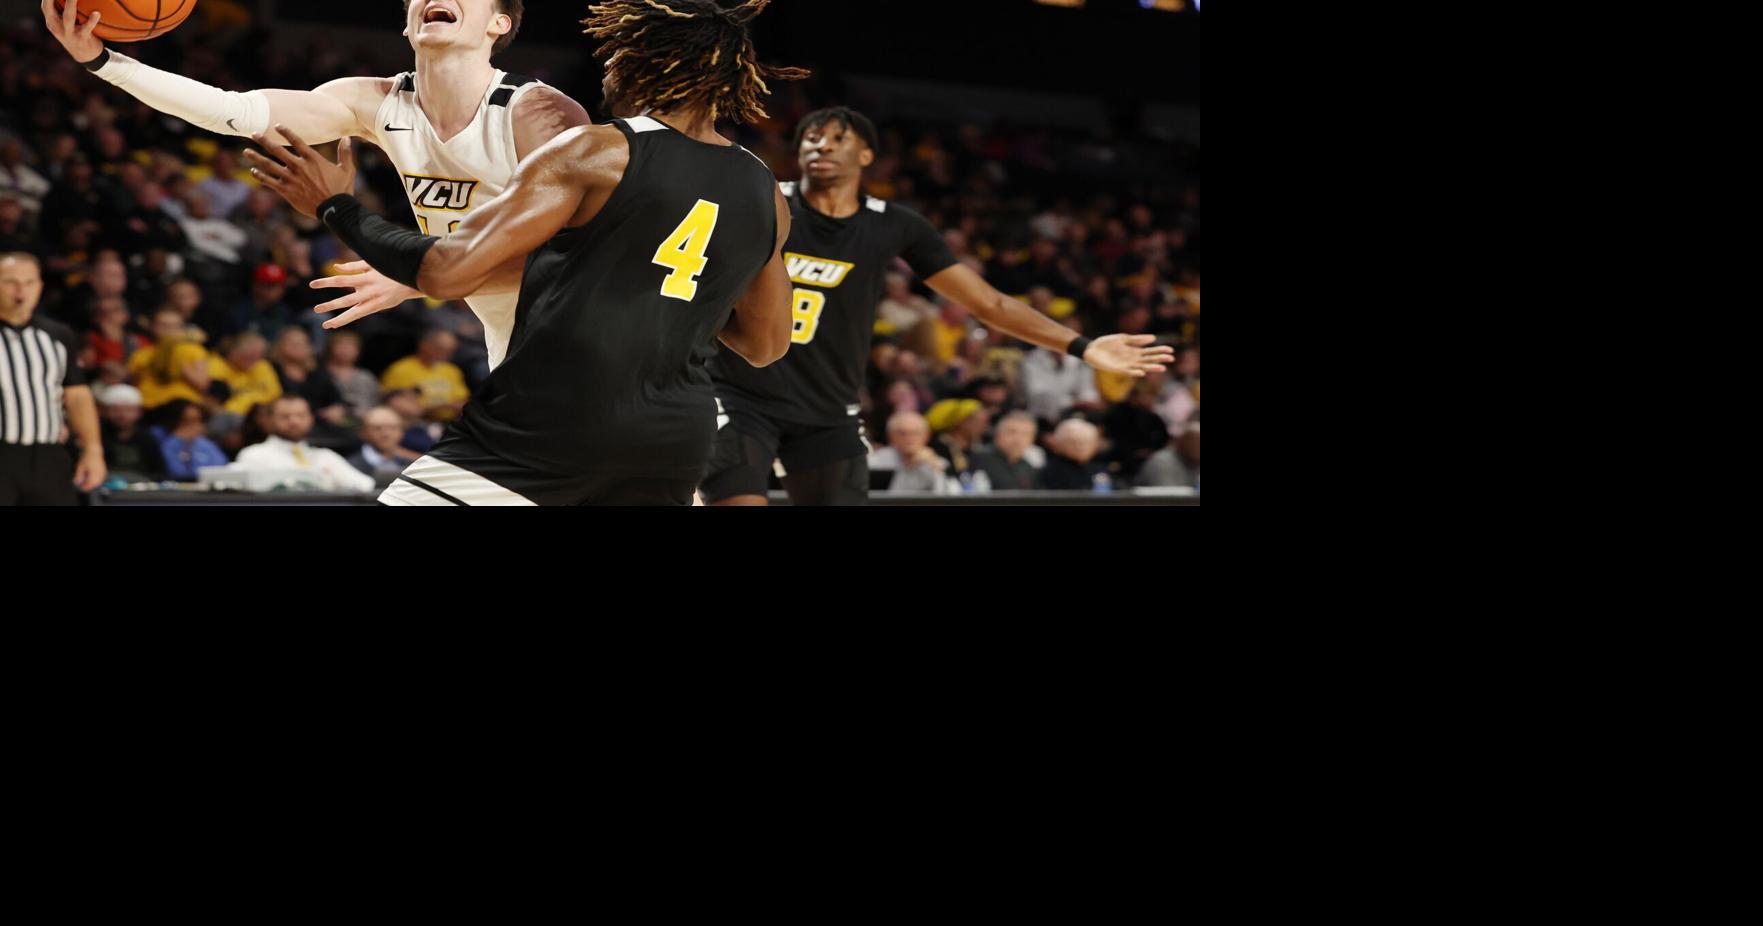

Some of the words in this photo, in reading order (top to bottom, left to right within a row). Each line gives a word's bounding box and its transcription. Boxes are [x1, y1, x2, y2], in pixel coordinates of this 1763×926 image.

[404, 176, 474, 208] VCU
[651, 199, 719, 302] 4
[785, 255, 848, 285] VCU
[791, 288, 825, 345] 8
